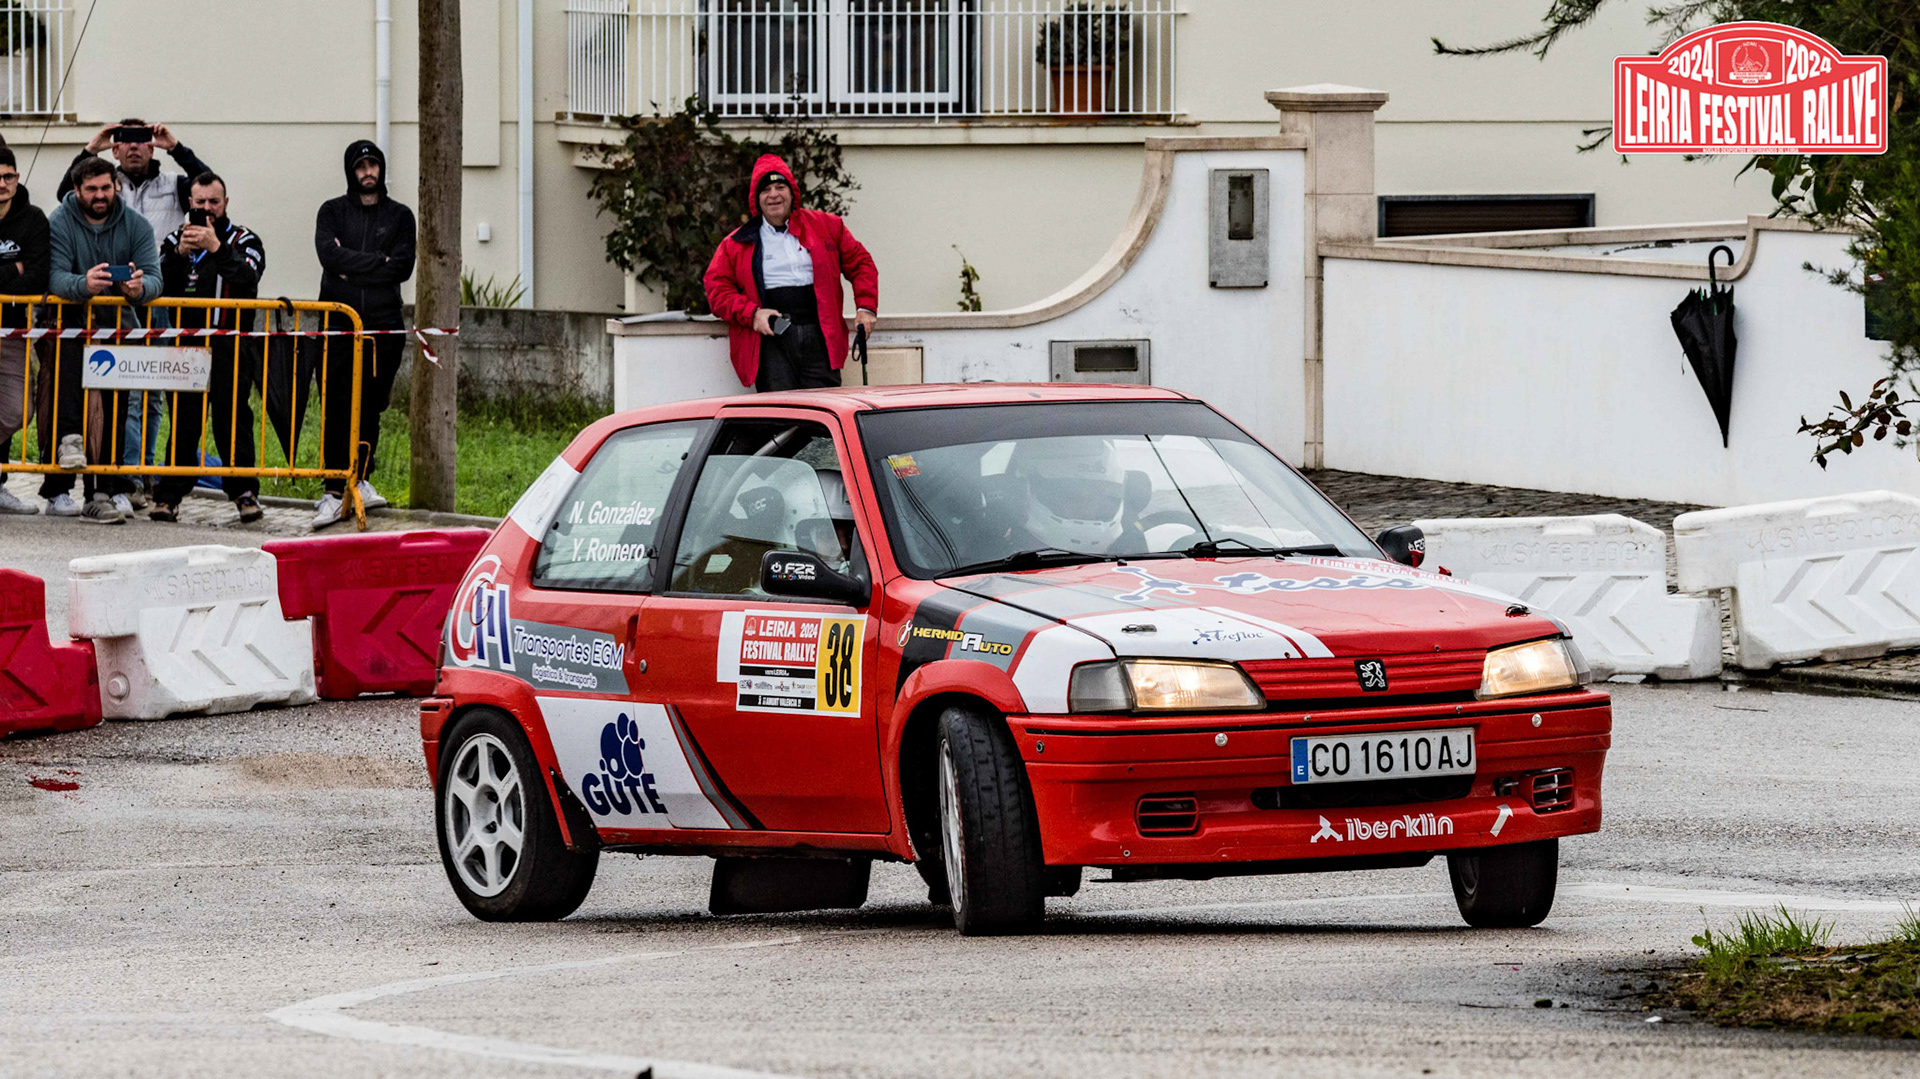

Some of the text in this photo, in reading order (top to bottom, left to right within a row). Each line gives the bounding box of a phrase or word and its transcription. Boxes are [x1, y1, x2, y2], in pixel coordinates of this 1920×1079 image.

[568, 500, 656, 526] N. González
[572, 538, 645, 562] Y. Romero
[759, 619, 818, 638] LEIRIA 2024
[514, 626, 625, 670] Transportes EGM
[742, 640, 817, 663] FESTIVAL RALLYE
[825, 623, 855, 707] 38
[564, 669, 597, 689] transporte
[1297, 765, 1305, 775] E
[582, 772, 669, 816] GUTE
[1345, 813, 1454, 841] iberklin
